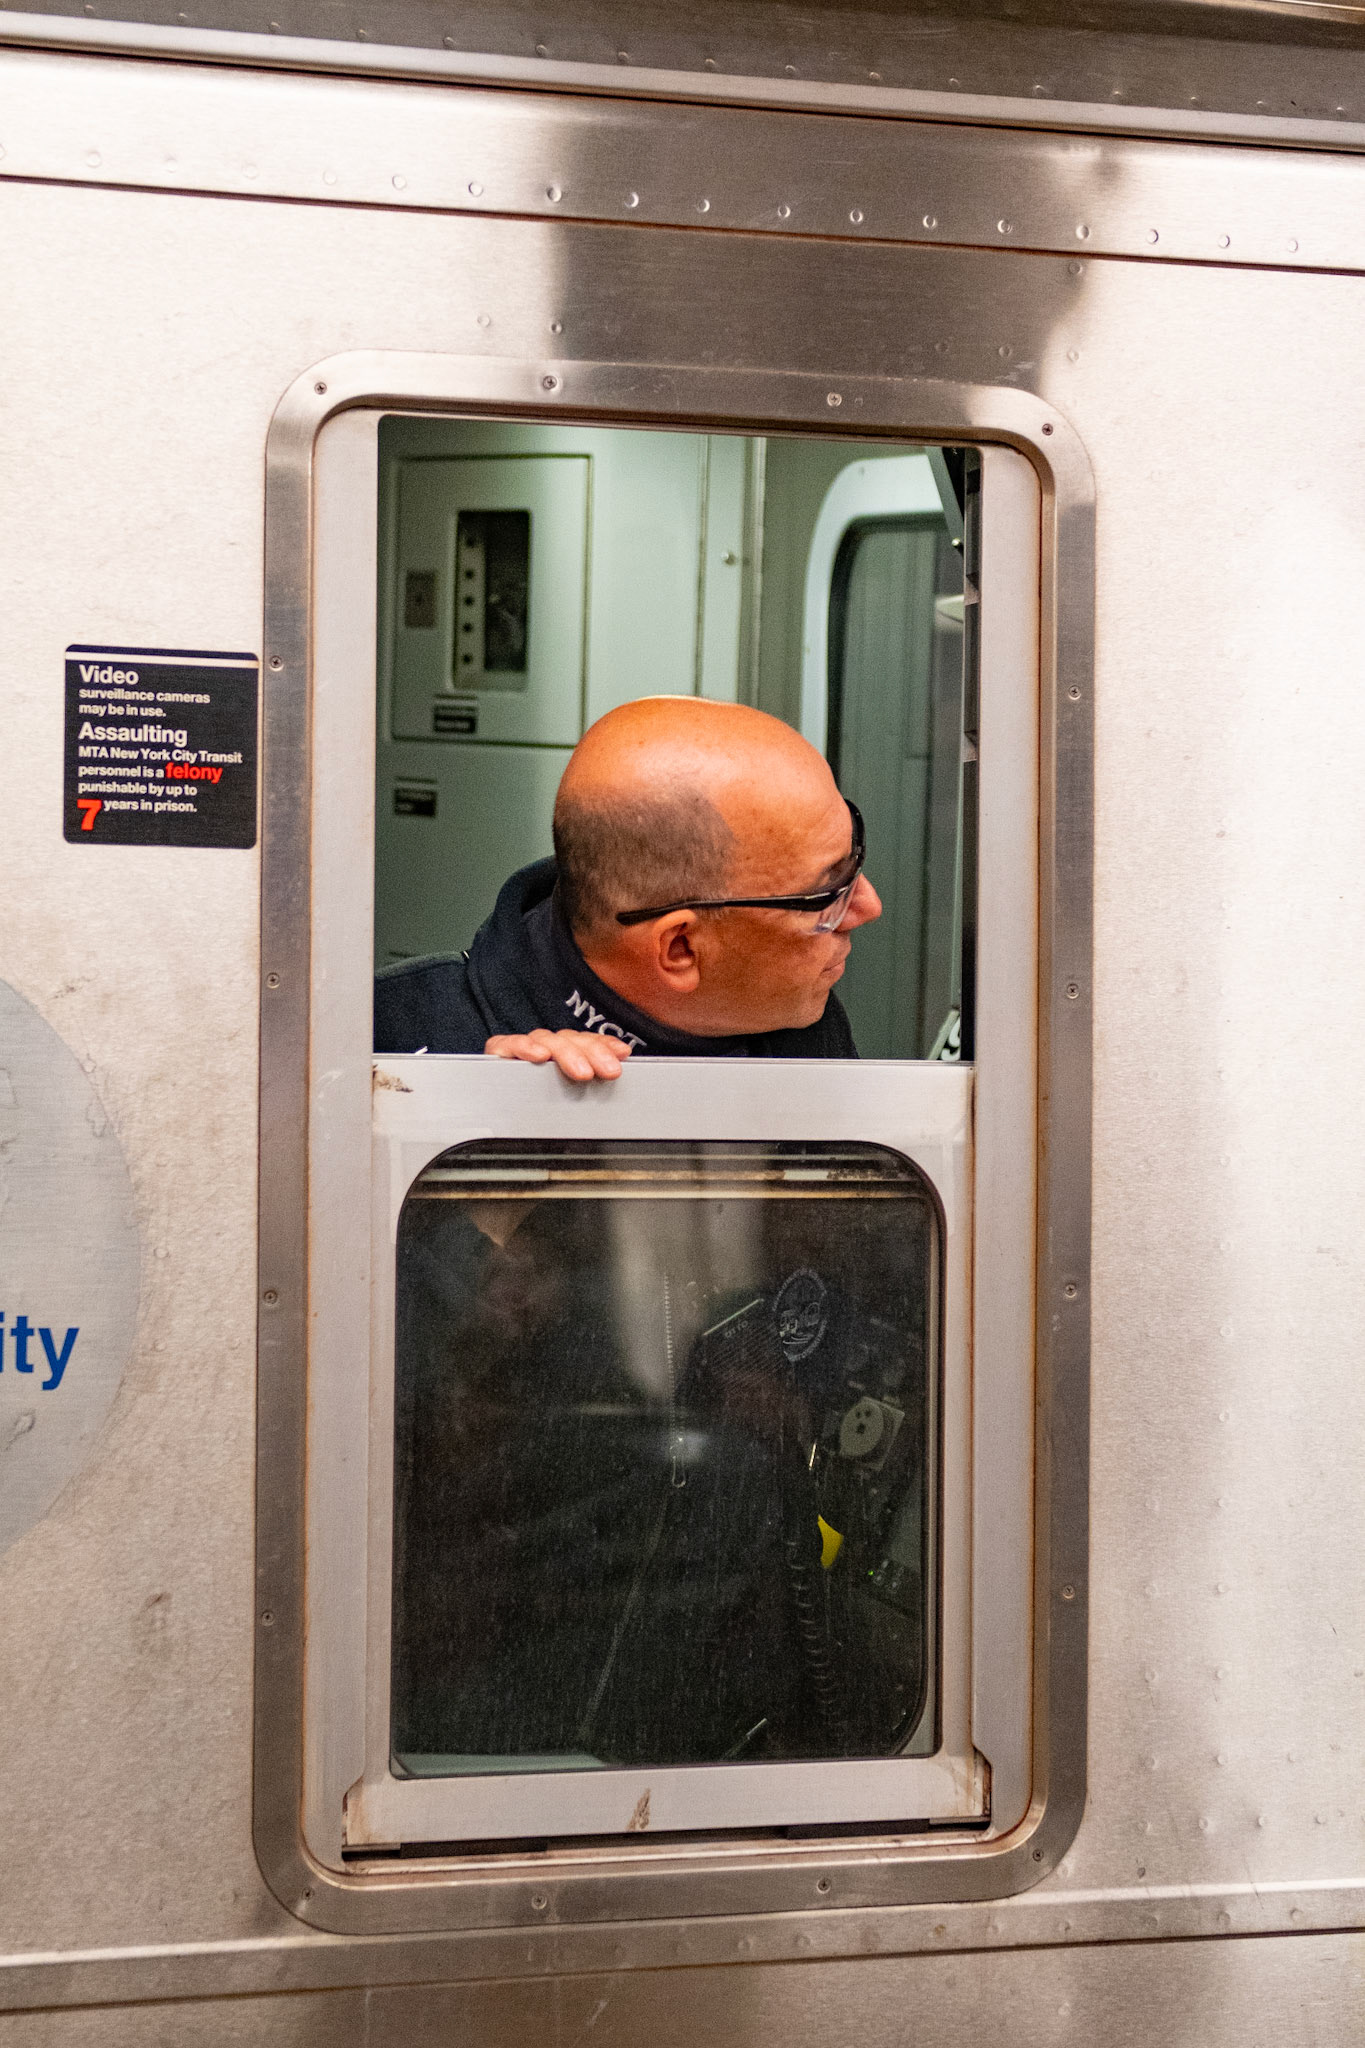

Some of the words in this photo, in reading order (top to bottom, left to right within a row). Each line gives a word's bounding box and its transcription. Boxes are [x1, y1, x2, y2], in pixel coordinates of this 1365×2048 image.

[79, 664, 139, 685] Video
[79, 688, 154, 701] surveillance
[156, 691, 210, 704] cameras
[79, 704, 106, 716] may
[108, 703, 125, 716] be
[127, 704, 138, 716] in
[140, 707, 166, 717] use.
[78, 722, 188, 747] Assaulting
[79, 746, 109, 759] MTA
[110, 747, 138, 760] New
[141, 749, 170, 761] York
[172, 750, 197, 764] City
[199, 751, 243, 764] Transit
[78, 766, 141, 777] personnel
[143, 767, 154, 778] is
[156, 770, 164, 778] a
[166, 762, 223, 784] felony
[78, 782, 147, 794] punishable
[148, 783, 164, 796] by
[166, 786, 182, 797] up
[184, 785, 197, 796] to
[77, 799, 102, 831] 7
[104, 801, 139, 812] years
[141, 800, 152, 811] in
[154, 801, 197, 813] prison.
[565, 989, 648, 1051] NYCT
